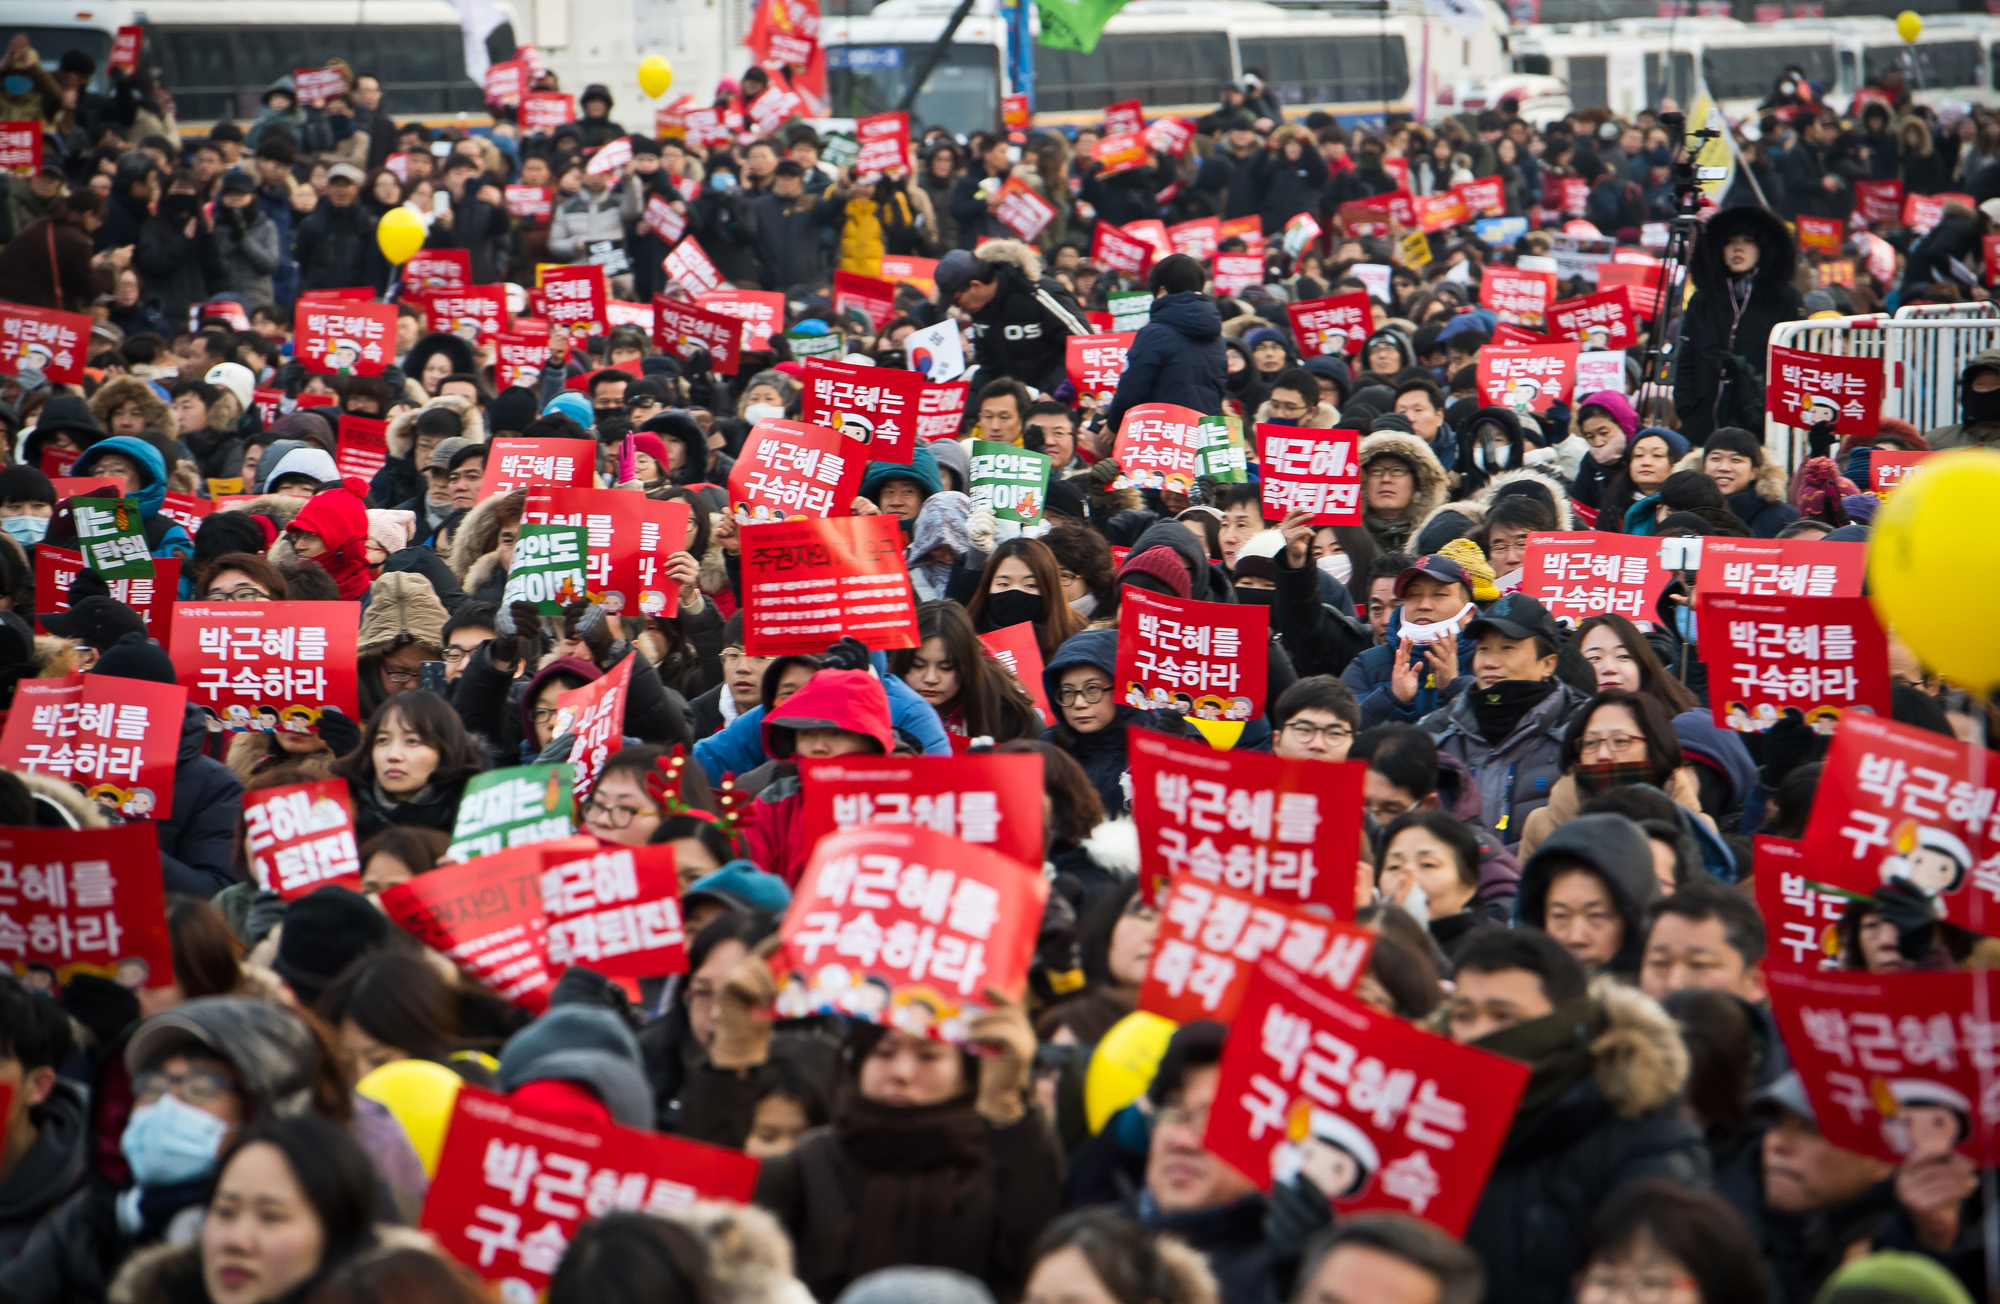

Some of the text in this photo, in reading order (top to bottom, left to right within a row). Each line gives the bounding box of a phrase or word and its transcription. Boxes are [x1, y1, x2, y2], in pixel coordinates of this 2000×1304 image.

[432, 297, 500, 317] 박근혜는
[434, 317, 500, 334] 구 속
[1297, 306, 1364, 331] 박근혜는
[1556, 302, 1624, 330] 박근혜는
[3, 316, 79, 349] 박근혜는
[307, 313, 386, 340] 박근혜는
[661, 323, 728, 362] 구 속
[662, 307, 733, 345] 박근혜는
[1302, 323, 1368, 350] 구 속
[1610, 321, 1628, 338] 속
[0, 340, 75, 371] 구 속
[306, 338, 384, 363] 구 속
[501, 345, 551, 367] 박근혜
[1490, 355, 1566, 378] 박근혜는
[813, 377, 906, 415] 박근혜는
[1488, 377, 1562, 399] 구 속
[1780, 363, 1869, 397] 박근혜는
[1781, 389, 1868, 421] 구 속
[874, 418, 902, 446] 속
[1127, 419, 1201, 448] 박근혜를
[499, 453, 576, 483] 박근혜를
[755, 437, 847, 487] 박근혜를
[1216, 447, 1248, 475] 탄핵
[1265, 436, 1351, 478] 박근혜
[744, 469, 837, 520] 구속하라
[1263, 476, 1362, 515] 즉각퇴진
[73, 506, 120, 538] 는
[90, 534, 154, 571] 탄핵
[1542, 551, 1650, 588] 박근혜를
[1723, 561, 1838, 598] 박근혜를
[1537, 585, 1645, 619] 구속하라
[198, 626, 330, 661] 박근혜를
[1137, 612, 1243, 658] 박근혜를
[1729, 620, 1858, 662] 박근혜를
[197, 667, 328, 702] 구속하라
[1134, 650, 1242, 693] 구속하라
[1730, 662, 1860, 702] 구속하라
[31, 702, 151, 742] 박근혜를
[18, 744, 145, 783] 구속하라
[454, 776, 548, 840] 헌재는
[1155, 770, 1324, 846] 박근혜를
[1840, 809, 1890, 860] 구
[273, 830, 361, 892] 퇴진
[1157, 826, 1320, 901] 구속하라
[815, 853, 1002, 942] 박근혜를
[792, 908, 989, 996] 구속하라
[1166, 882, 1369, 992] 국정교과서
[1780, 923, 1819, 966] 구
[1260, 1002, 1468, 1150] 박근혜는
[1824, 1070, 1873, 1126] 구
[1240, 1073, 1441, 1216] 구 속
